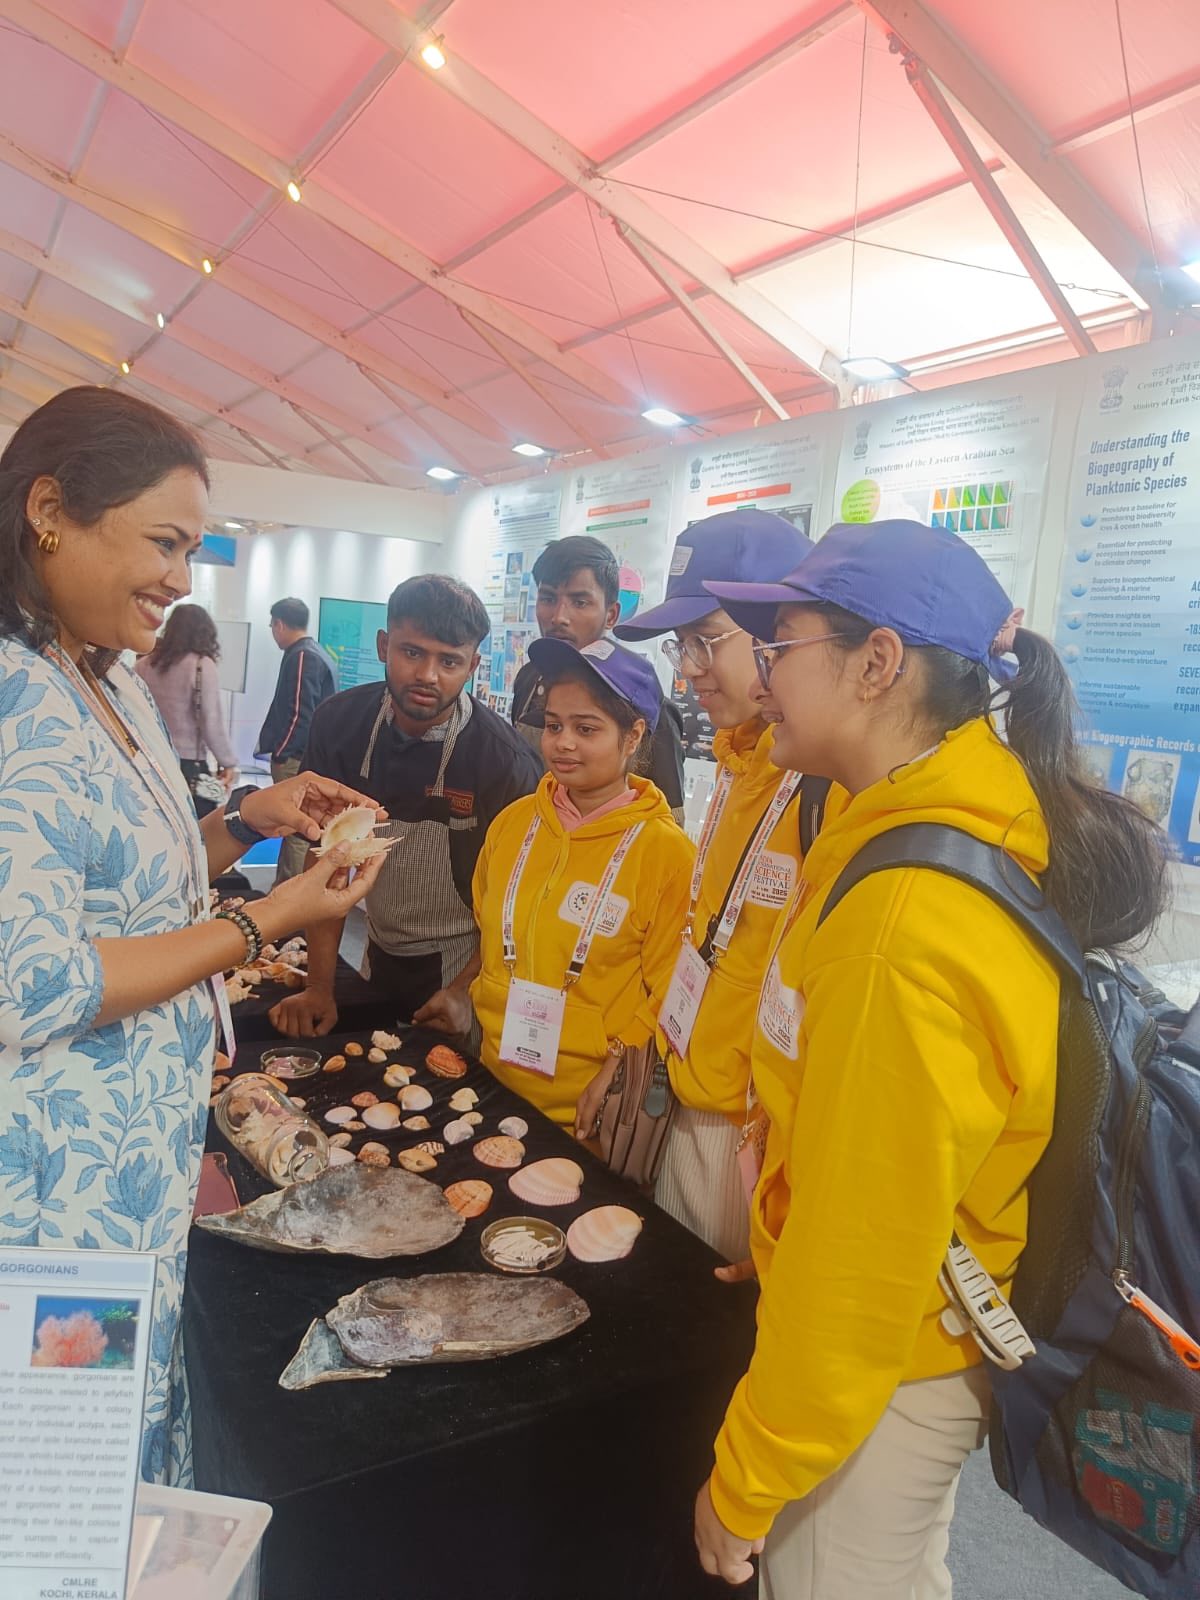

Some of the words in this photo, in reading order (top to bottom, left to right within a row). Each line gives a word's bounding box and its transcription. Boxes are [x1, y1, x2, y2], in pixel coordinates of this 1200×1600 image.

[1162, 398, 1169, 407] of
[1090, 433, 1168, 454] Understanding
[1171, 429, 1190, 443] the
[962, 449, 997, 461] Arabian
[999, 447, 1015, 456] Sea
[1088, 455, 1159, 477] Biogeography
[1162, 452, 1175, 466] of
[1086, 478, 1141, 496] Planktonic
[1143, 474, 1187, 493] Species
[1102, 505, 1130, 514] Provides
[1137, 503, 1165, 511] baseline
[1136, 511, 1176, 520] biodiversity
[1141, 520, 1162, 528] health
[1097, 541, 1126, 549] Essential
[1137, 539, 1172, 548] predicting
[1096, 550, 1130, 559] ecosystem
[1131, 549, 1166, 557] responses
[1126, 558, 1151, 567] change
[1092, 577, 1120, 585] Supports
[1122, 576, 1175, 584] biogeochemical
[1131, 594, 1161, 602] planning
[1116, 612, 1140, 620] insights
[1128, 648, 1155, 656] regional
[1103, 683, 1141, 691] sustainable
[1156, 737, 1194, 752] Records
[755, 865, 791, 881] SCIENCE
[753, 873, 790, 889] FESTIVAL
[0, 1263, 79, 1275] GORGONIANS
[62, 1578, 98, 1587] CMLRE
[40, 1589, 74, 1600] KOCHI,
[77, 1590, 117, 1600] KERALA
